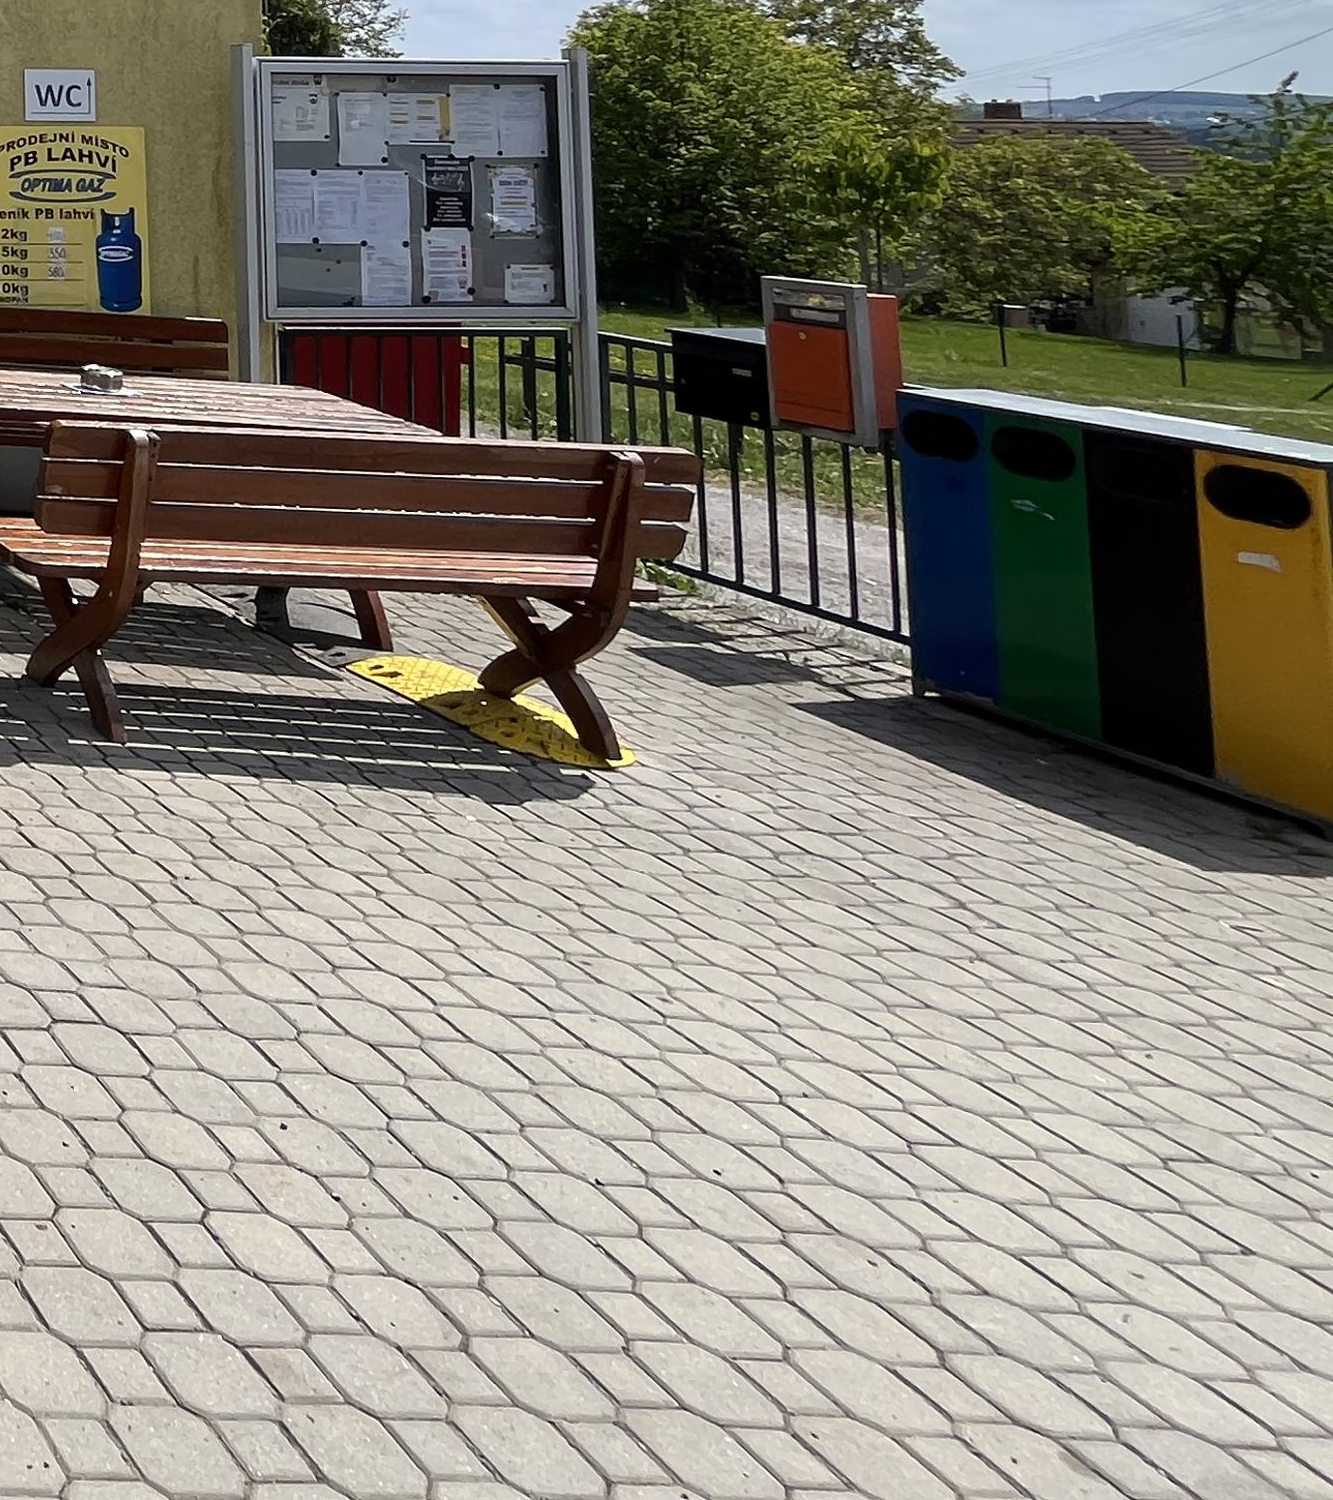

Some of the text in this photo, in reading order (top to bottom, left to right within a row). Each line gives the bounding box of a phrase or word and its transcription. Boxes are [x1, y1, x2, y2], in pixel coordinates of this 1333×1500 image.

[35, 84, 82, 108] WC
[81, 134, 130, 158] MÍSTO
[9, 147, 117, 173] PB LAHVÍ
[21, 178, 106, 193] OPTIMA GAZ
[35, 208, 54, 220] PB
[59, 207, 95, 220] lahví
[1, 228, 28, 242] 2kg
[1, 246, 28, 260] 5kg
